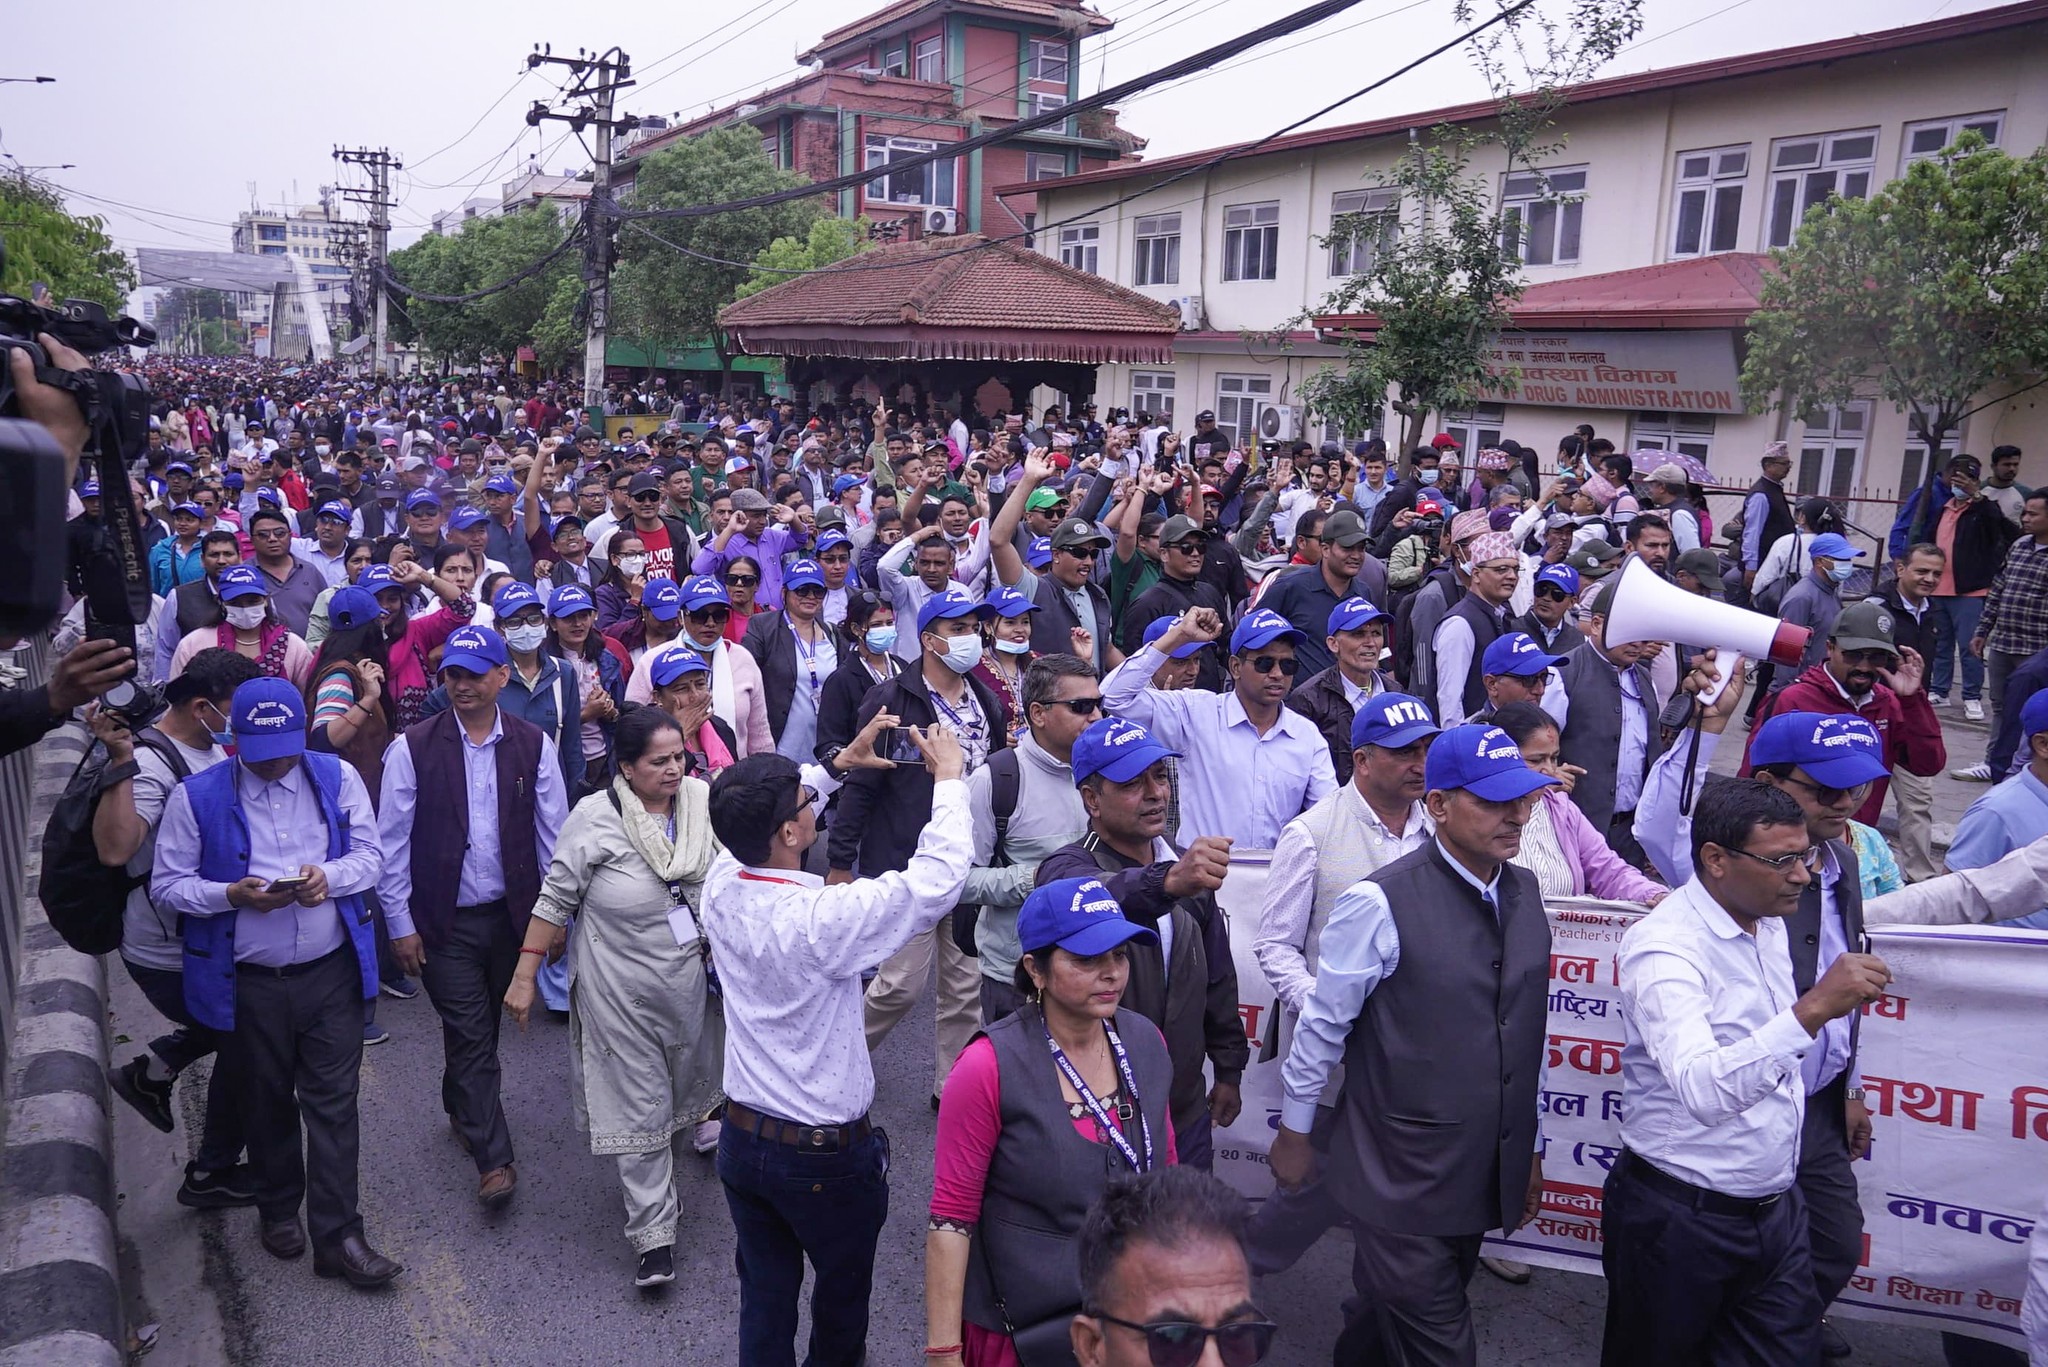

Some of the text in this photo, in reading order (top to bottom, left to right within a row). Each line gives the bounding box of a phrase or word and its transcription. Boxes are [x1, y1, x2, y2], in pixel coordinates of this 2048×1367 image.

[1531, 337, 1569, 347] सरकार
[1568, 352, 1607, 365] मन्त्रालय
[1593, 365, 1677, 384] विभाग
[1524, 385, 1567, 403] DRUG
[1576, 387, 1732, 410] ADMINISTRATION
[115, 506, 142, 581] Panasonic
[253, 715, 287, 728] नवलपुर
[1383, 701, 1430, 727] NTA
[1112, 729, 1147, 746] नवलपुर
[1822, 735, 1851, 747] नवलपु
[1551, 926, 1611, 943] Teacher's
[1547, 989, 1609, 1020] ाष्ट्रिय
[1860, 1074, 1985, 1131] तथा
[1534, 1217, 1604, 1243] सम्बो
[1886, 1275, 1965, 1306] शिक्षा
